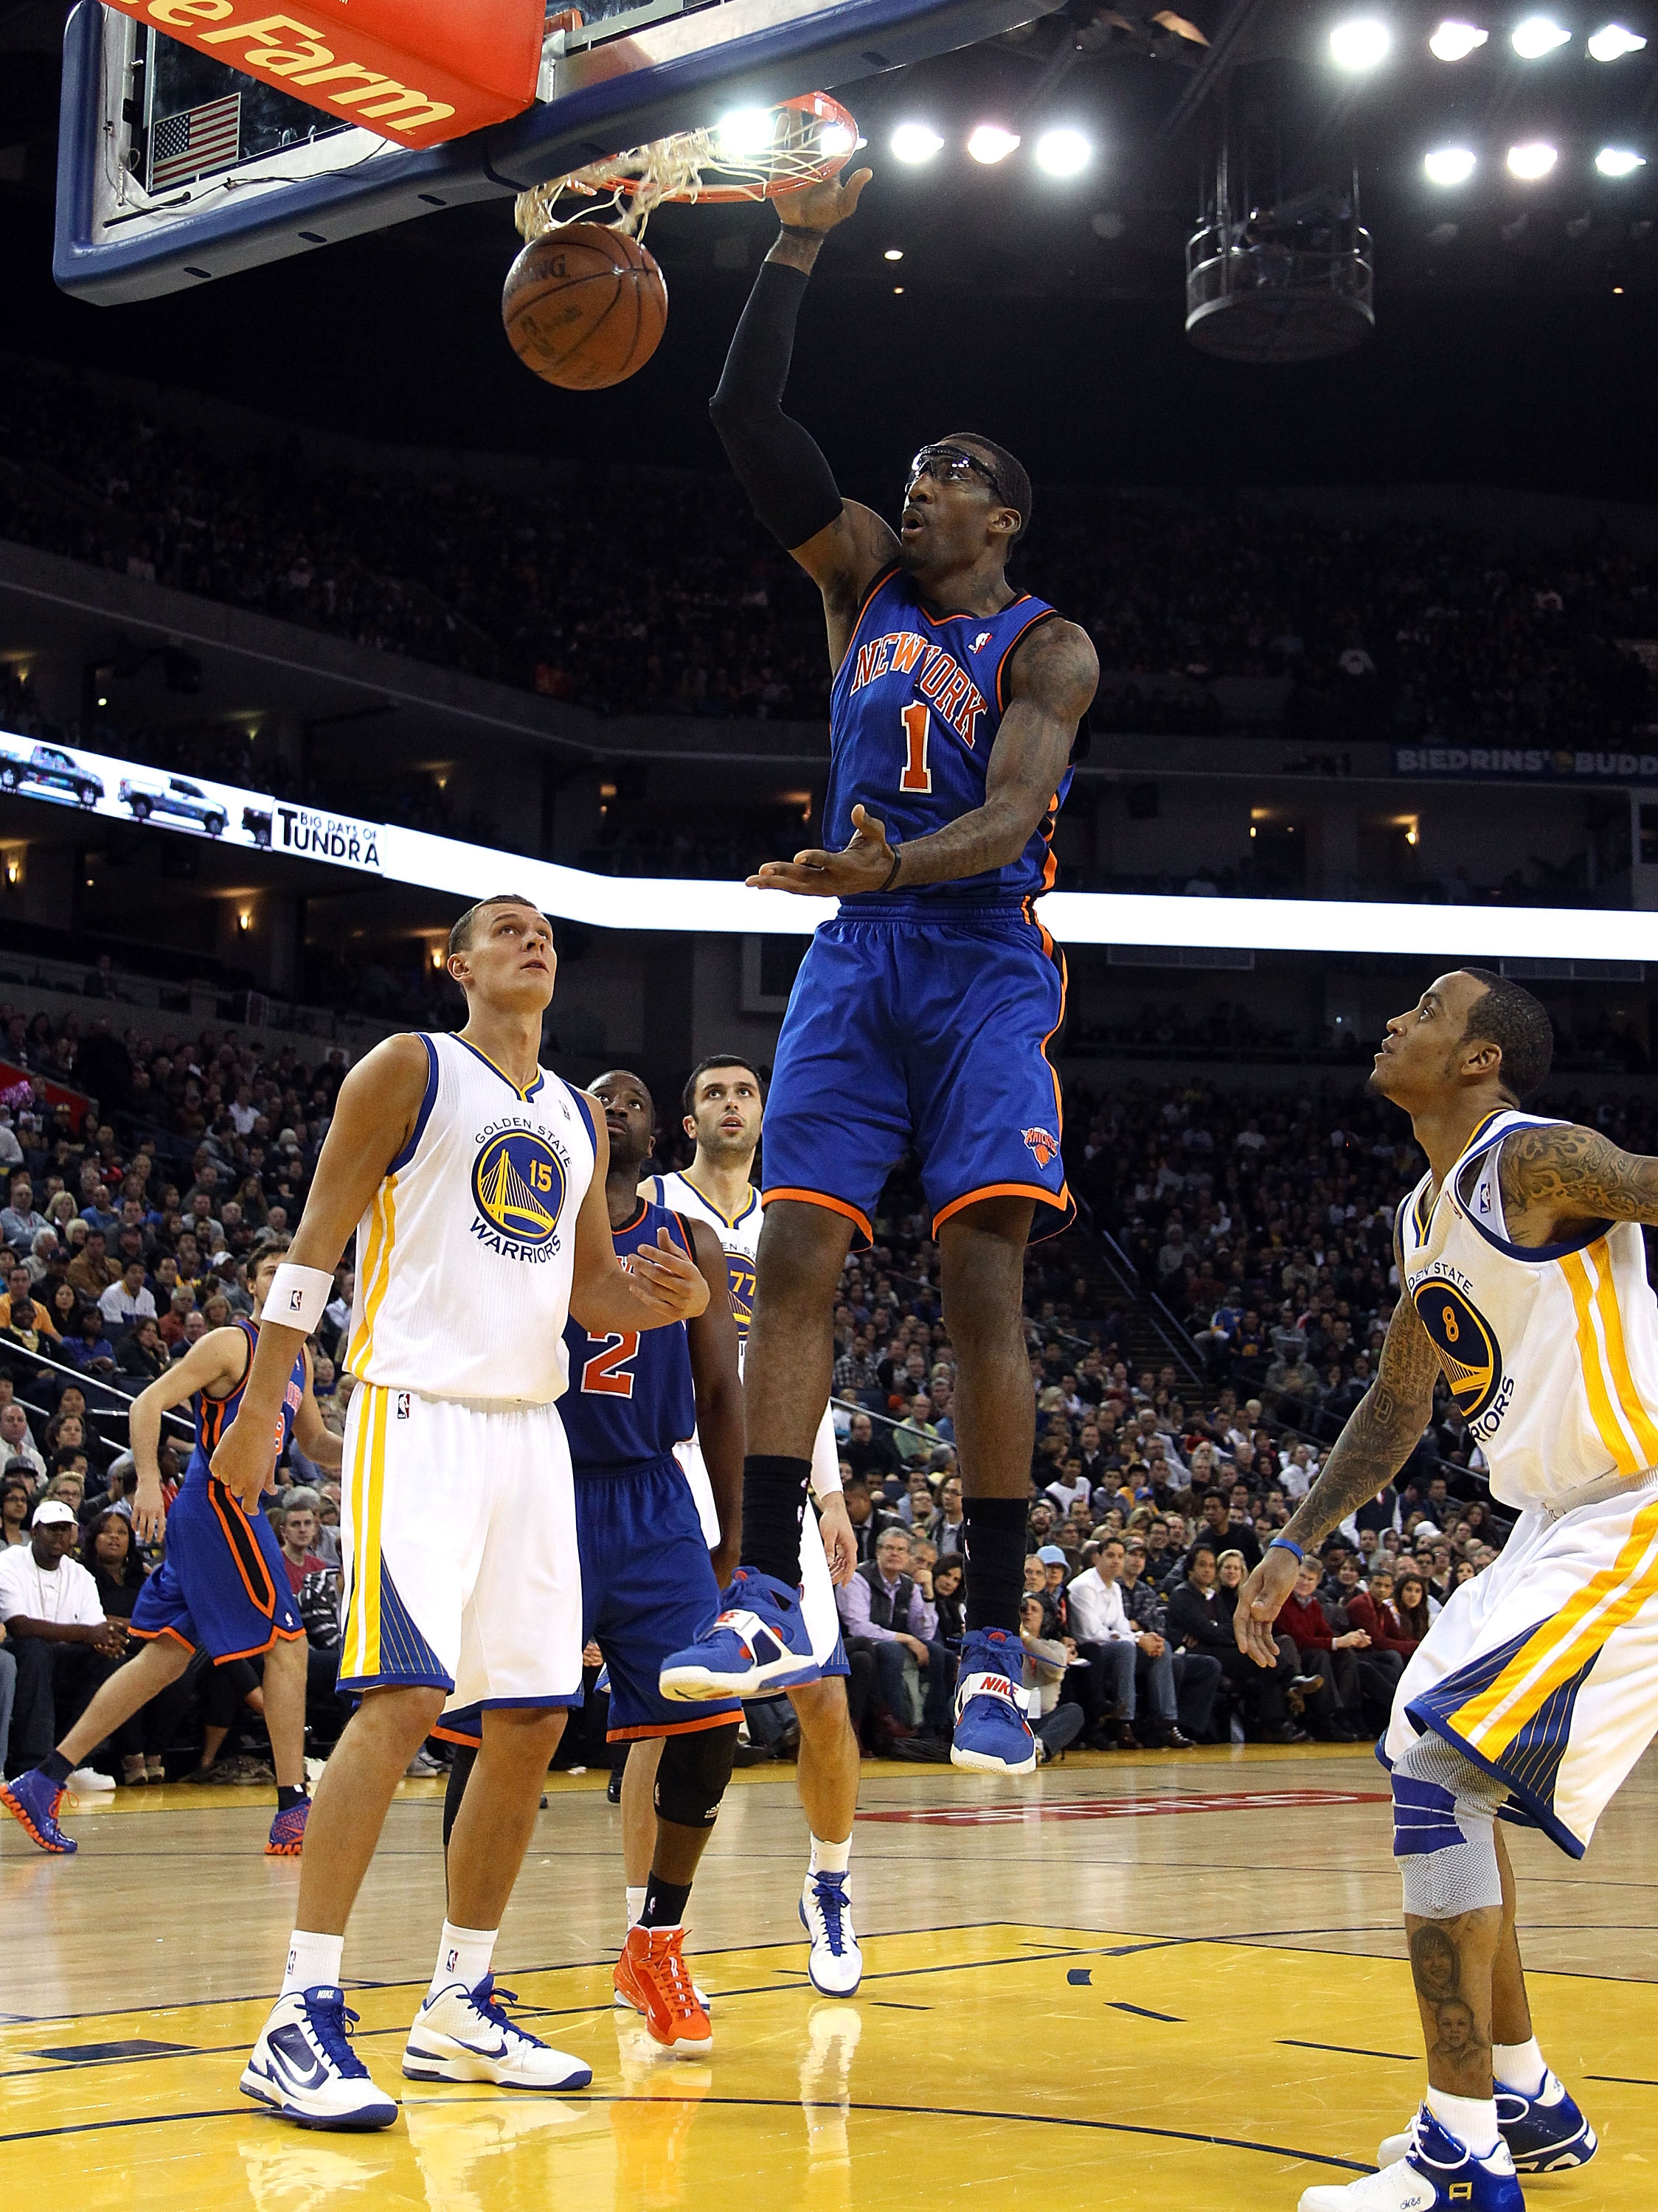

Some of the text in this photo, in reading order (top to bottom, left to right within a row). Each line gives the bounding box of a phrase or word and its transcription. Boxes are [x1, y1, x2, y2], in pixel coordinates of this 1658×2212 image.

[197, 14, 456, 131] Farm
[850, 631, 988, 751] NEW YORK
[899, 699, 932, 793] 1
[277, 807, 380, 867] TUNDRA
[300, 812, 377, 840] BIG DAYS OF
[474, 1117, 572, 1168] GOLDEN STATE
[1024, 1129, 1058, 1156] KNICKS
[529, 1159, 553, 1193] 15
[469, 1215, 561, 1264] WARRIORS
[729, 1269, 757, 1297] 77
[1434, 1262, 1473, 1295] STATE
[1443, 1306, 1460, 1342] 8
[316, 1989, 335, 1999] NIKE
